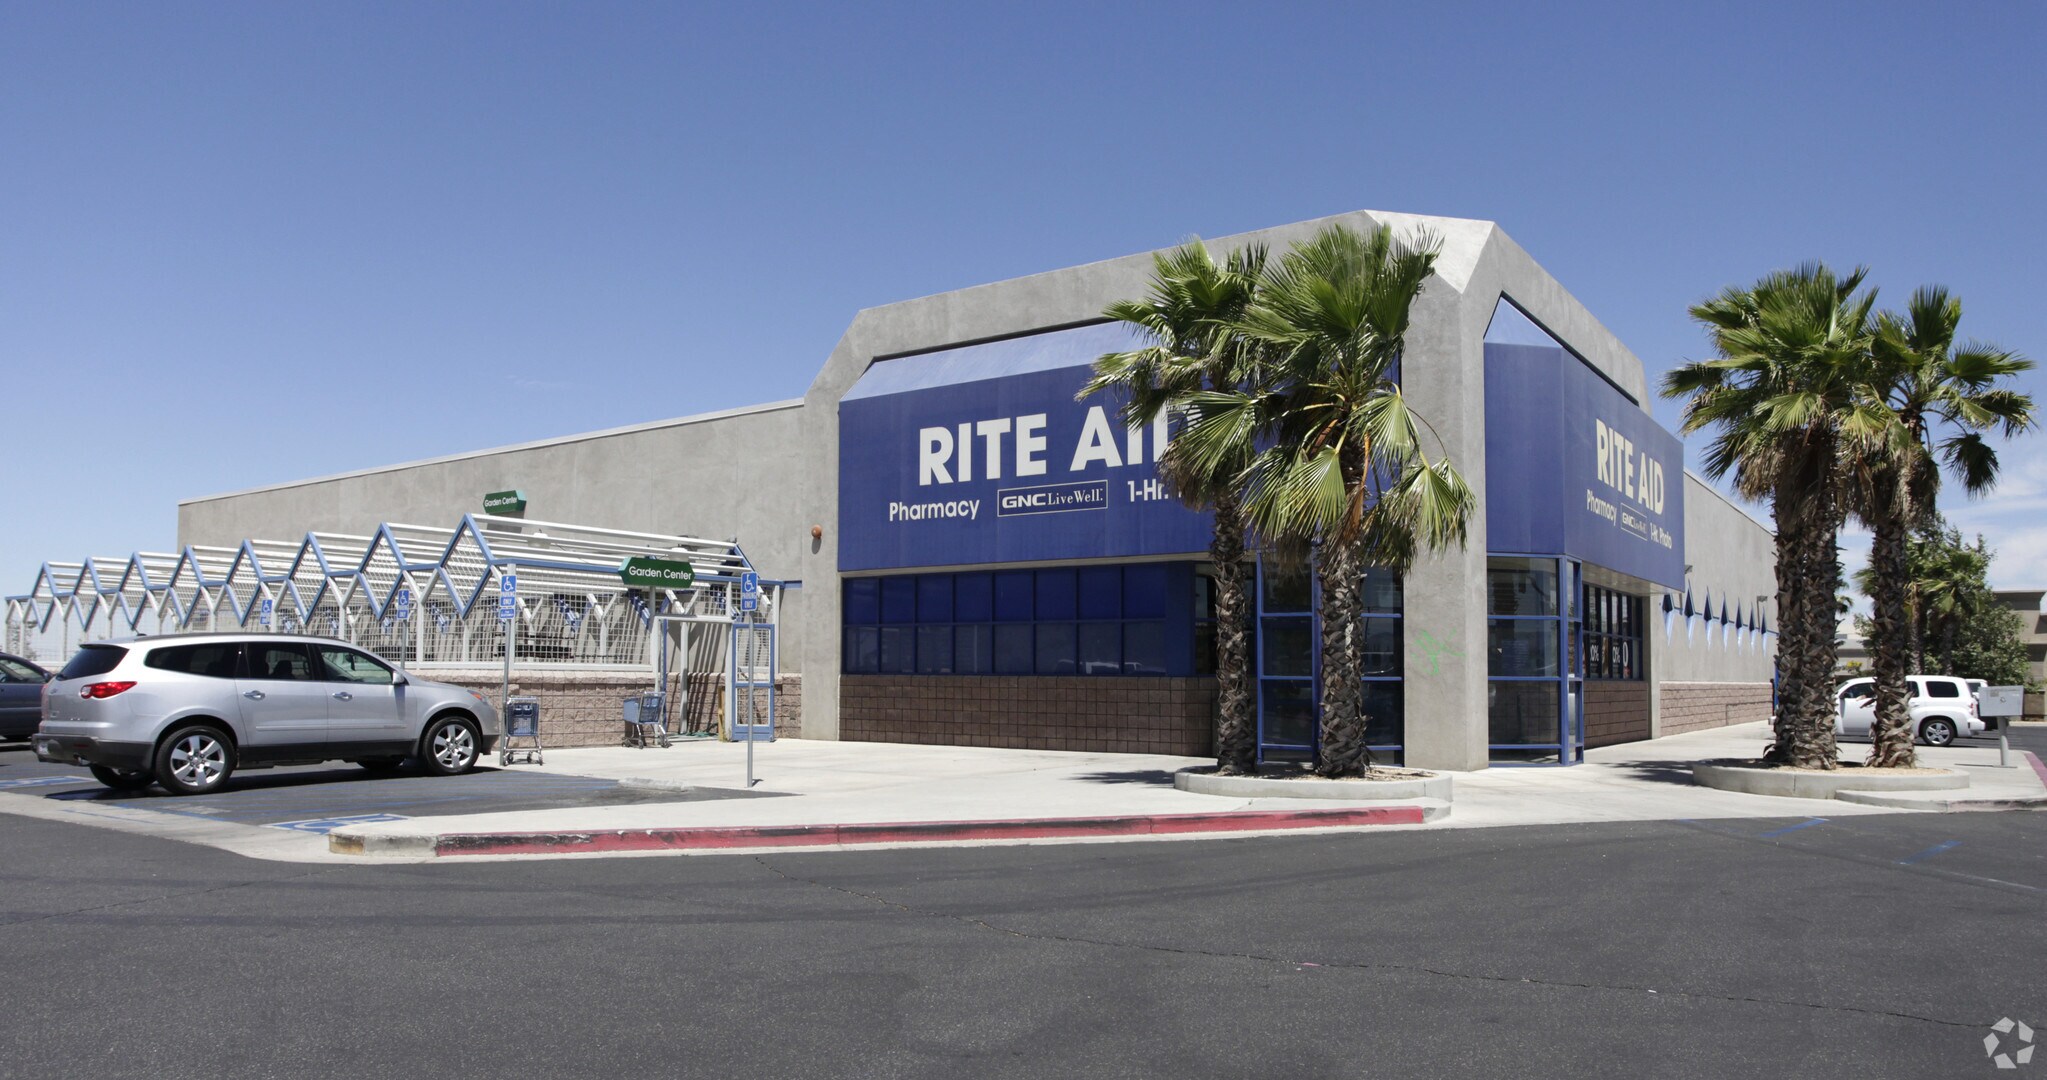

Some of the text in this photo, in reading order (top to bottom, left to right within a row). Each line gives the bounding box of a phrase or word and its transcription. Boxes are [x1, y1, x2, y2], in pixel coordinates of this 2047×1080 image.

[919, 413, 1047, 486] RITE
[1596, 418, 1664, 515] RITE AID
[484, 496, 518, 507] Garden Center
[889, 499, 980, 522] Pharmacy
[1002, 493, 1046, 509] GNC
[1586, 488, 1617, 526] Pharmacy
[629, 566, 692, 580] Garden Center
